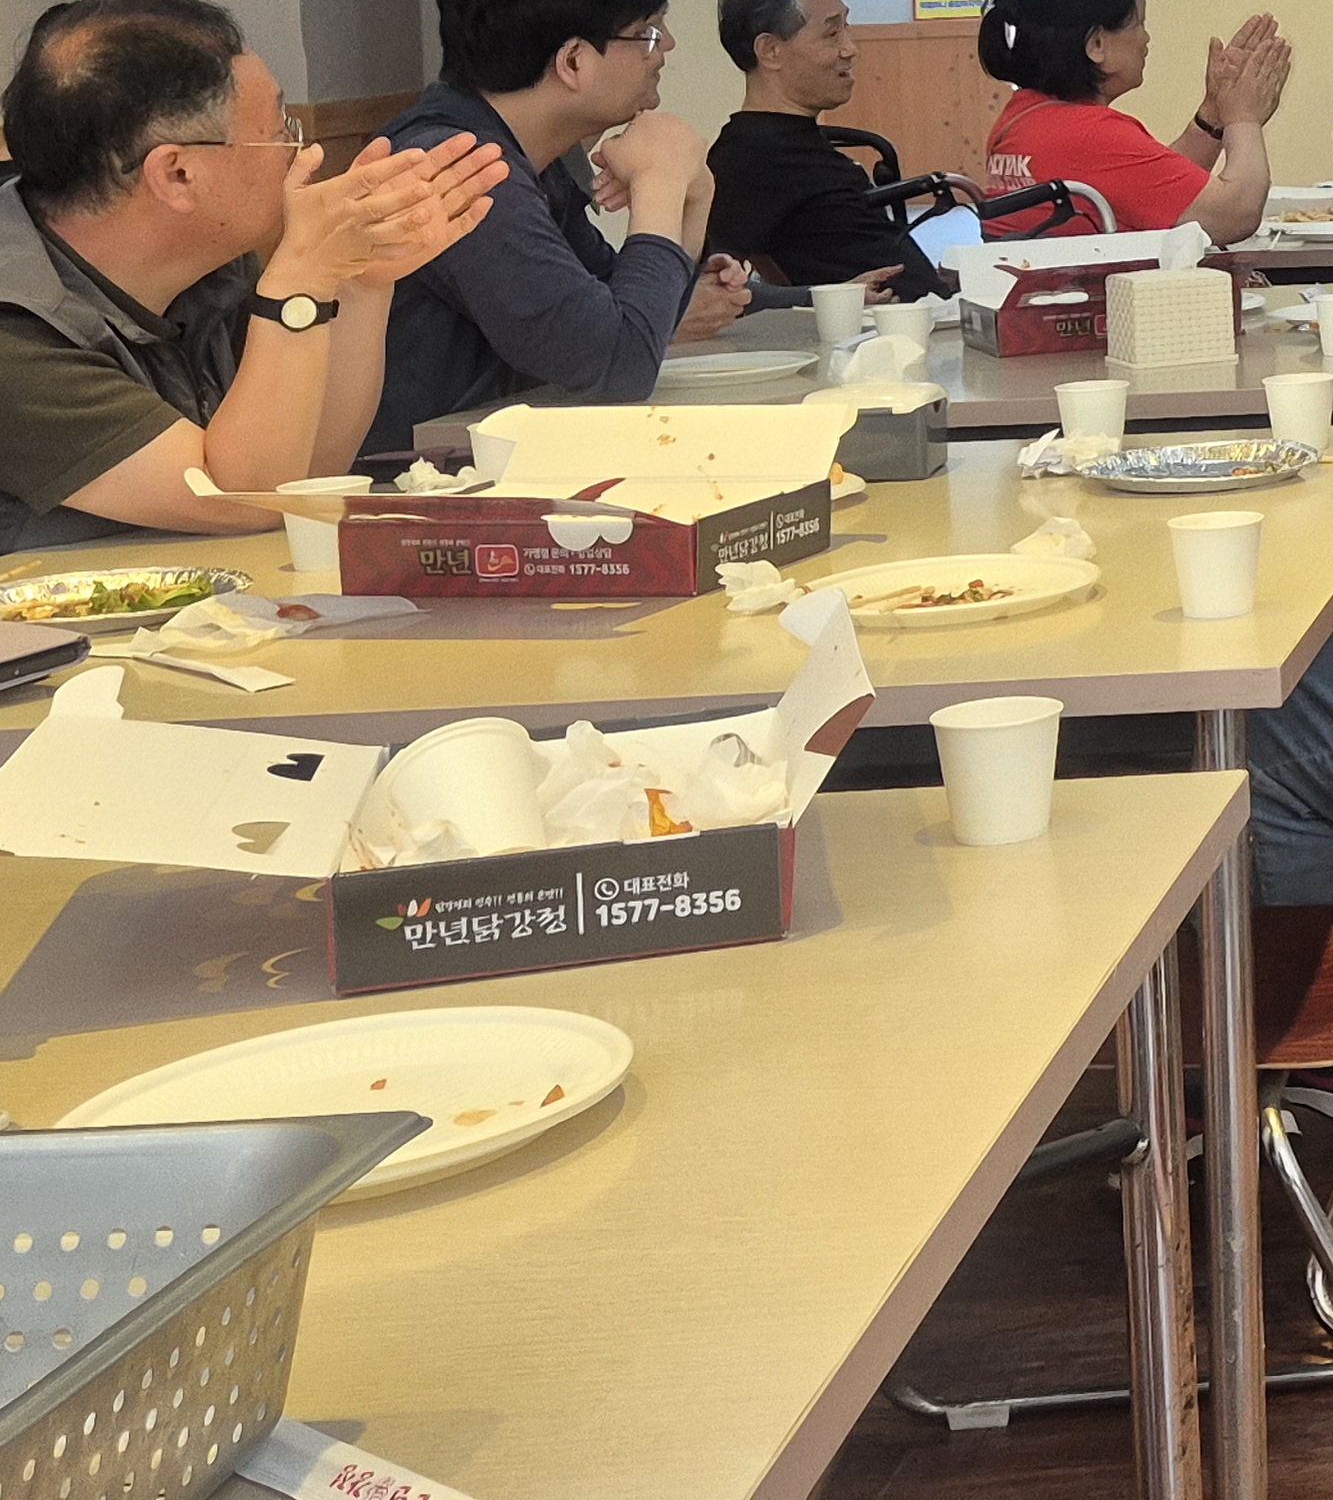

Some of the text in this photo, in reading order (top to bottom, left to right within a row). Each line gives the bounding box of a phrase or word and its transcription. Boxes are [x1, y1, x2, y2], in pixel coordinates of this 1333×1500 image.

[419, 548, 472, 575] 만년
[569, 563, 630, 576] 1577-8356
[623, 871, 689, 894] 대표전화
[595, 888, 743, 927] 1577-8356
[403, 904, 567, 950] 만년닭강정
